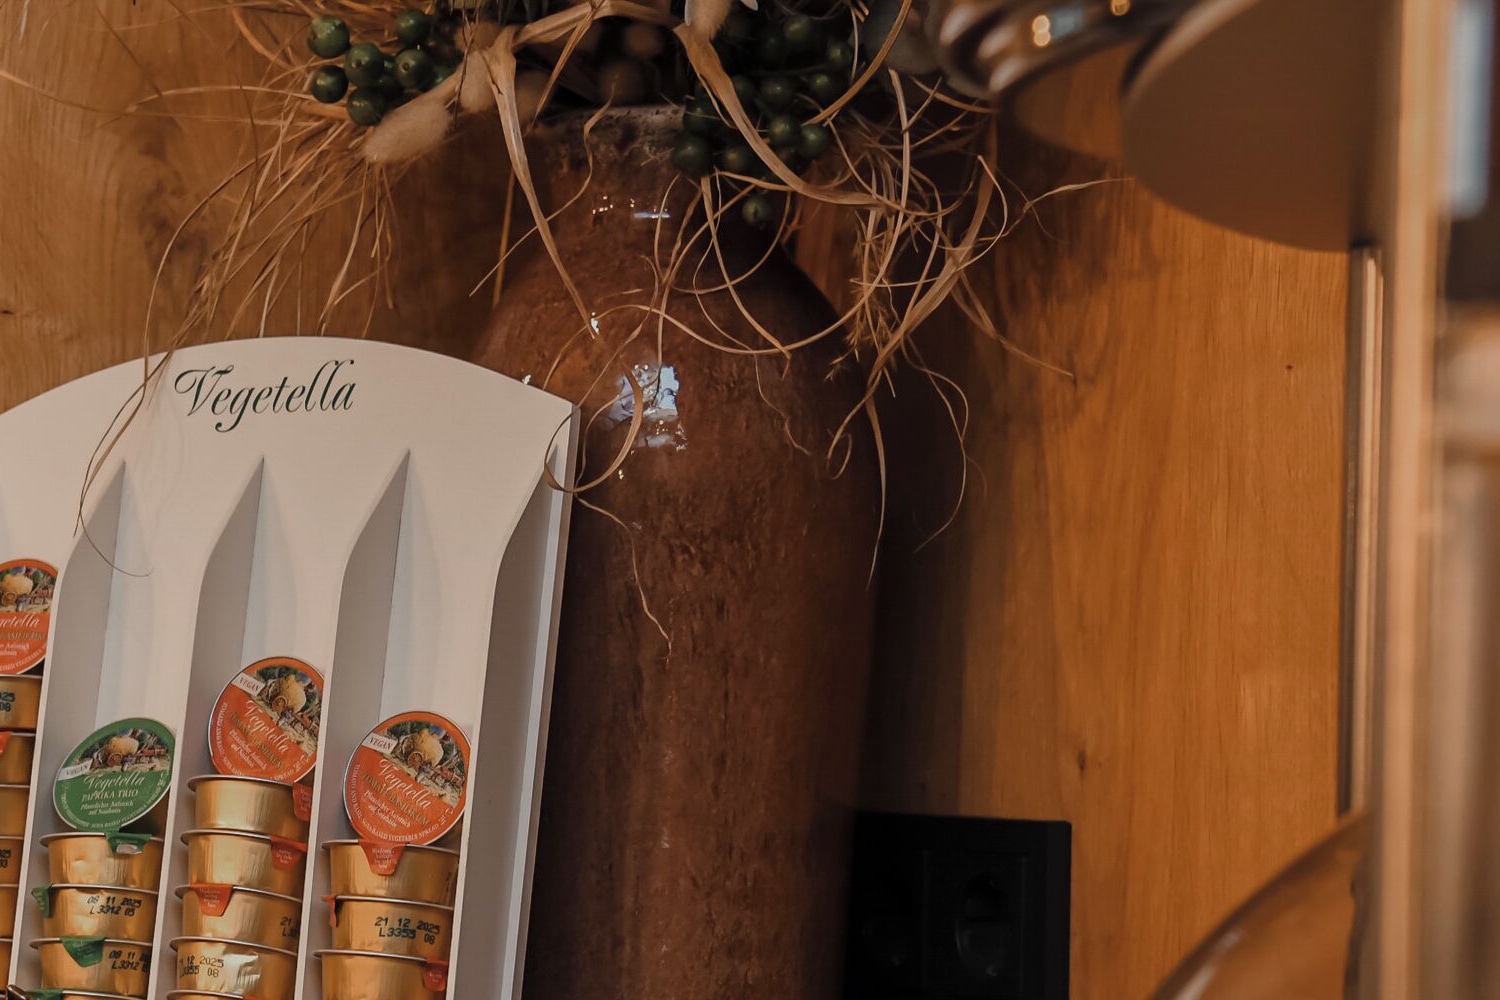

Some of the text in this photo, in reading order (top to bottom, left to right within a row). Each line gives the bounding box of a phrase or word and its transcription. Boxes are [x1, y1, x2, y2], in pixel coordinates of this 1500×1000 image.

[174, 359, 356, 433] Vegetella
[240, 677, 260, 691] VEGAN
[0, 704, 11, 712] 08
[245, 700, 289, 753] Vegetella
[370, 737, 393, 751] VEGAN
[84, 771, 145, 793] Vegetella
[379, 758, 432, 809] Vegetella
[82, 789, 139, 802] PAPRIKA TRIO
[106, 896, 115, 904] 11
[280, 916, 292, 926] 21
[375, 916, 440, 934] 21 12 2025
[424, 933, 435, 945] 08
[128, 951, 135, 959] 11
[200, 956, 224, 969] 2025
[207, 968, 219, 978] 08
